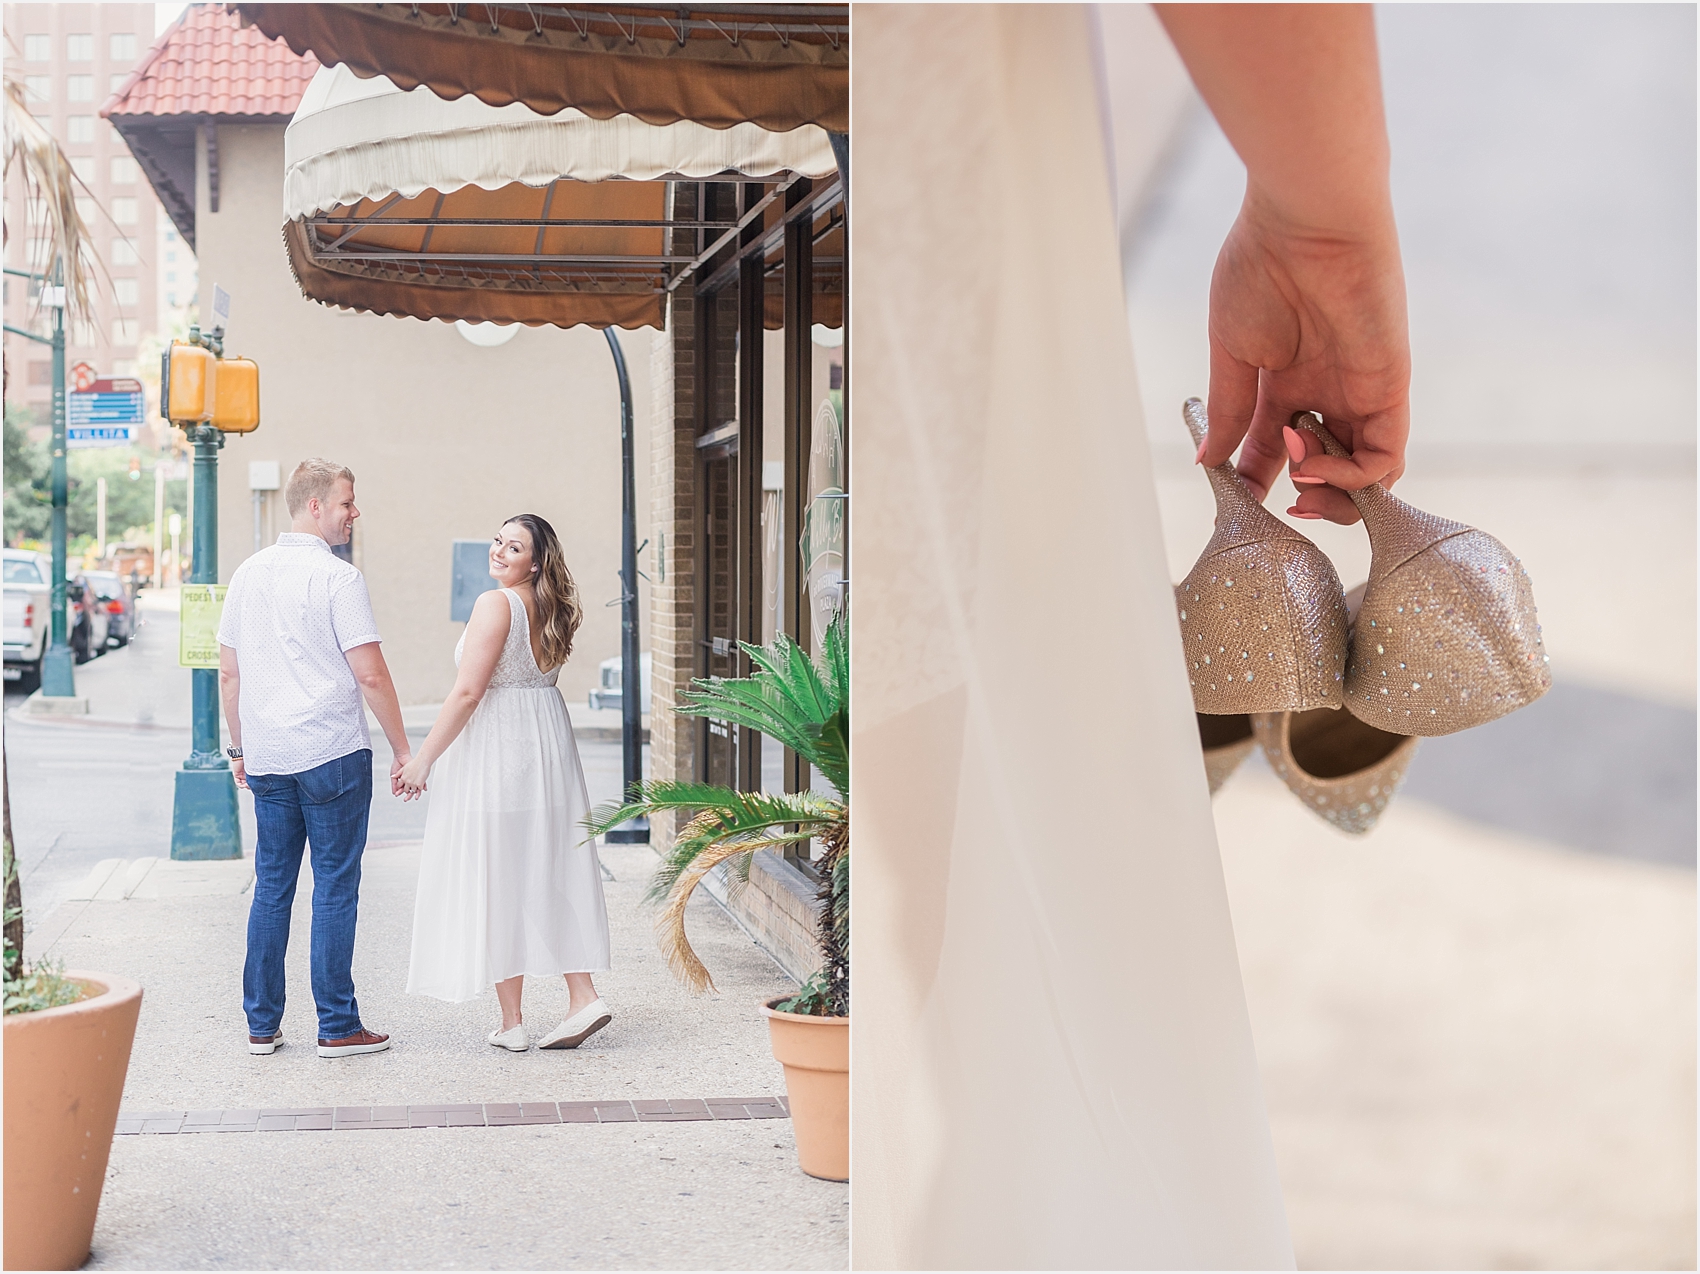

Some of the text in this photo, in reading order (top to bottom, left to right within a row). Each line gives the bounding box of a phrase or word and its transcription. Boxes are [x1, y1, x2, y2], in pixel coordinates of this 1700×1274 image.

[72, 429, 126, 440] VILLITA
[185, 593, 225, 602] PEDESTIA
[187, 651, 220, 660] CROSSIN
